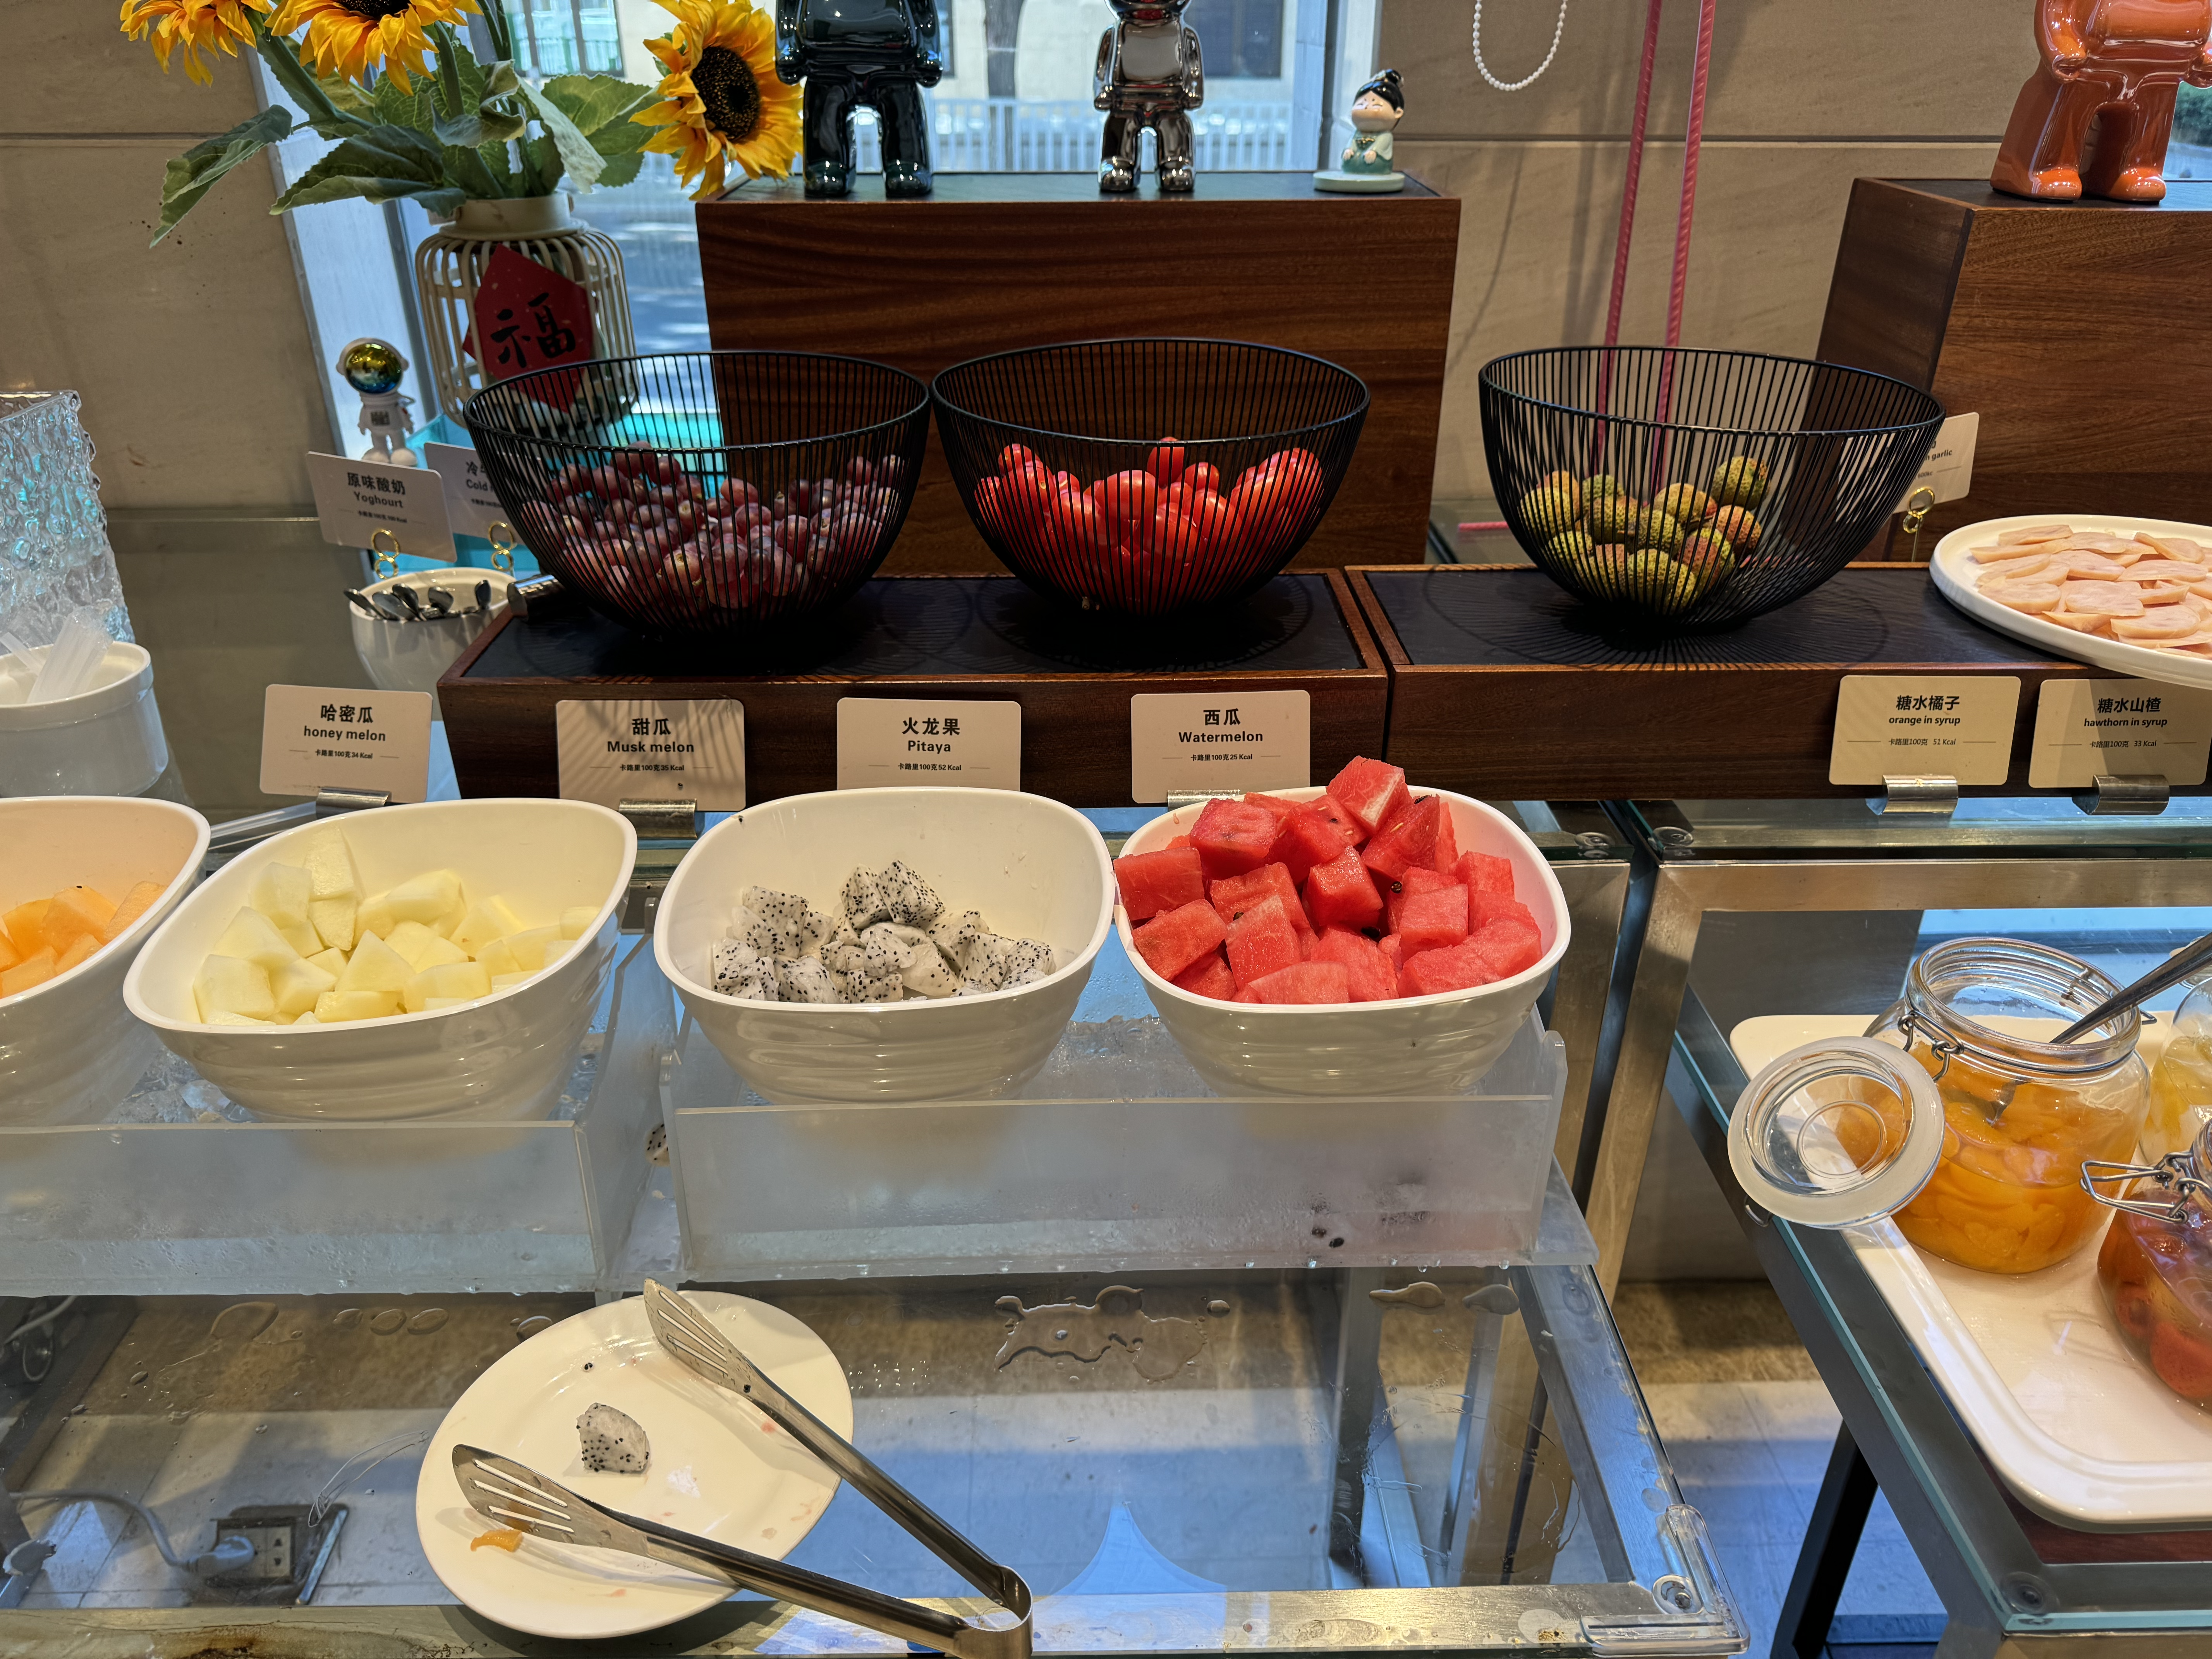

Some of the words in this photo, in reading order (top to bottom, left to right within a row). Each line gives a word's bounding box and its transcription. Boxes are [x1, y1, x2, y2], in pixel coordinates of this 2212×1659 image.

[491, 292, 576, 368] 福
[1932, 450, 1952, 461] garlic
[348, 472, 405, 495] 原味酸奶
[466, 479, 488, 491] Cold
[354, 491, 403, 508] Yoghourt
[1896, 695, 1960, 710] 糖水橘子
[2097, 697, 2161, 713] 糖水山楂
[321, 704, 373, 723] 哈密瓜
[1203, 708, 1240, 725] 西瓜
[632, 718, 671, 735] 甜瓜
[902, 717, 960, 735] 火龙果
[1889, 718, 1922, 726] orange
[2084, 718, 2128, 726] hawthorn
[2131, 718, 2139, 726] in
[2142, 720, 2167, 728] syrup
[304, 726, 342, 740] honey
[346, 730, 386, 741] melon
[1179, 731, 1262, 742] Watermelon
[608, 741, 646, 752] Musk
[651, 741, 694, 752] melon
[908, 740, 950, 754] Pitaya
